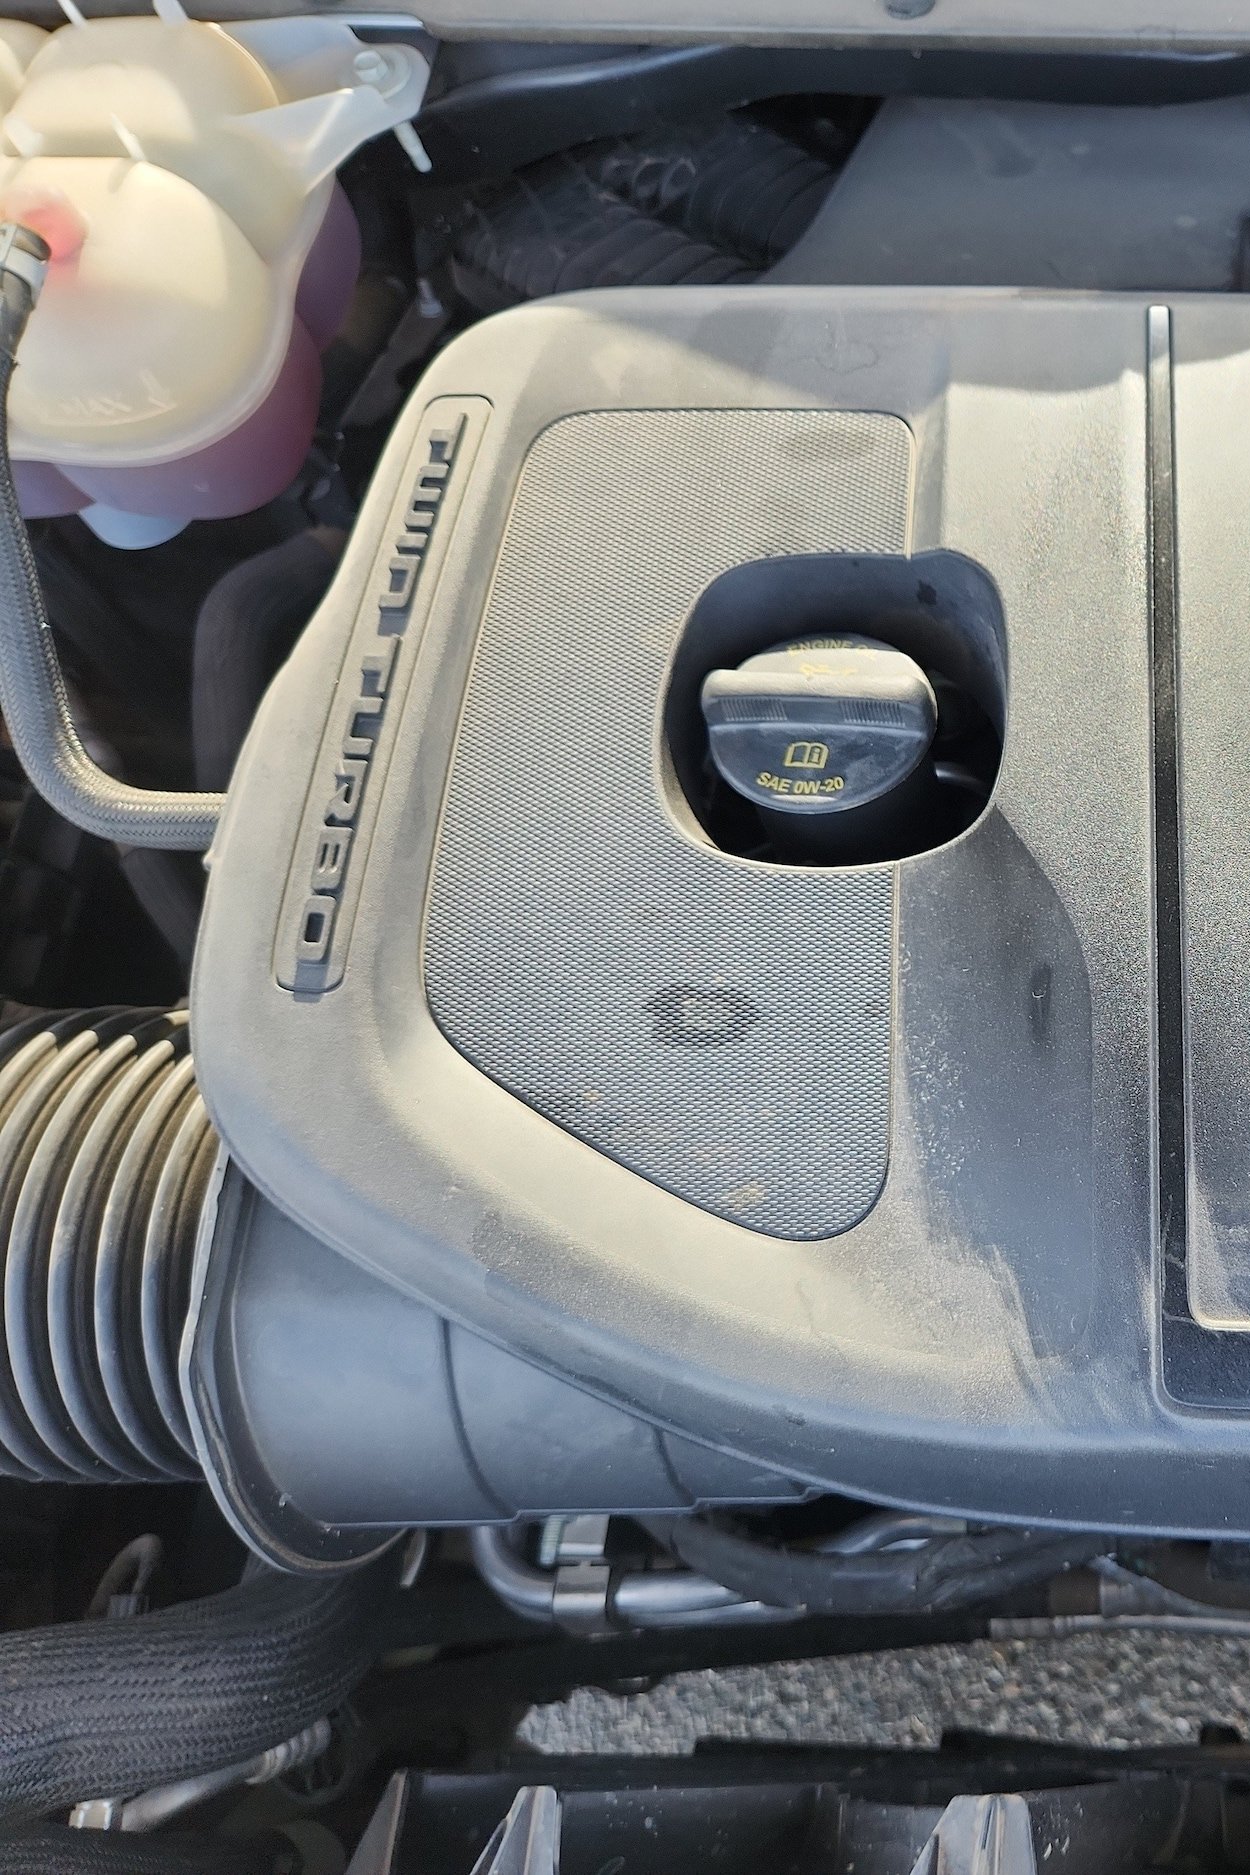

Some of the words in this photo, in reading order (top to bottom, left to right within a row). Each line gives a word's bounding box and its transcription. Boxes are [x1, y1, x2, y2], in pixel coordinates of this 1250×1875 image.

[378, 412, 470, 614] TWIN
[296, 632, 403, 964] TURBO
[756, 772, 792, 793] SAE
[793, 776, 845, 795] 0W-20
